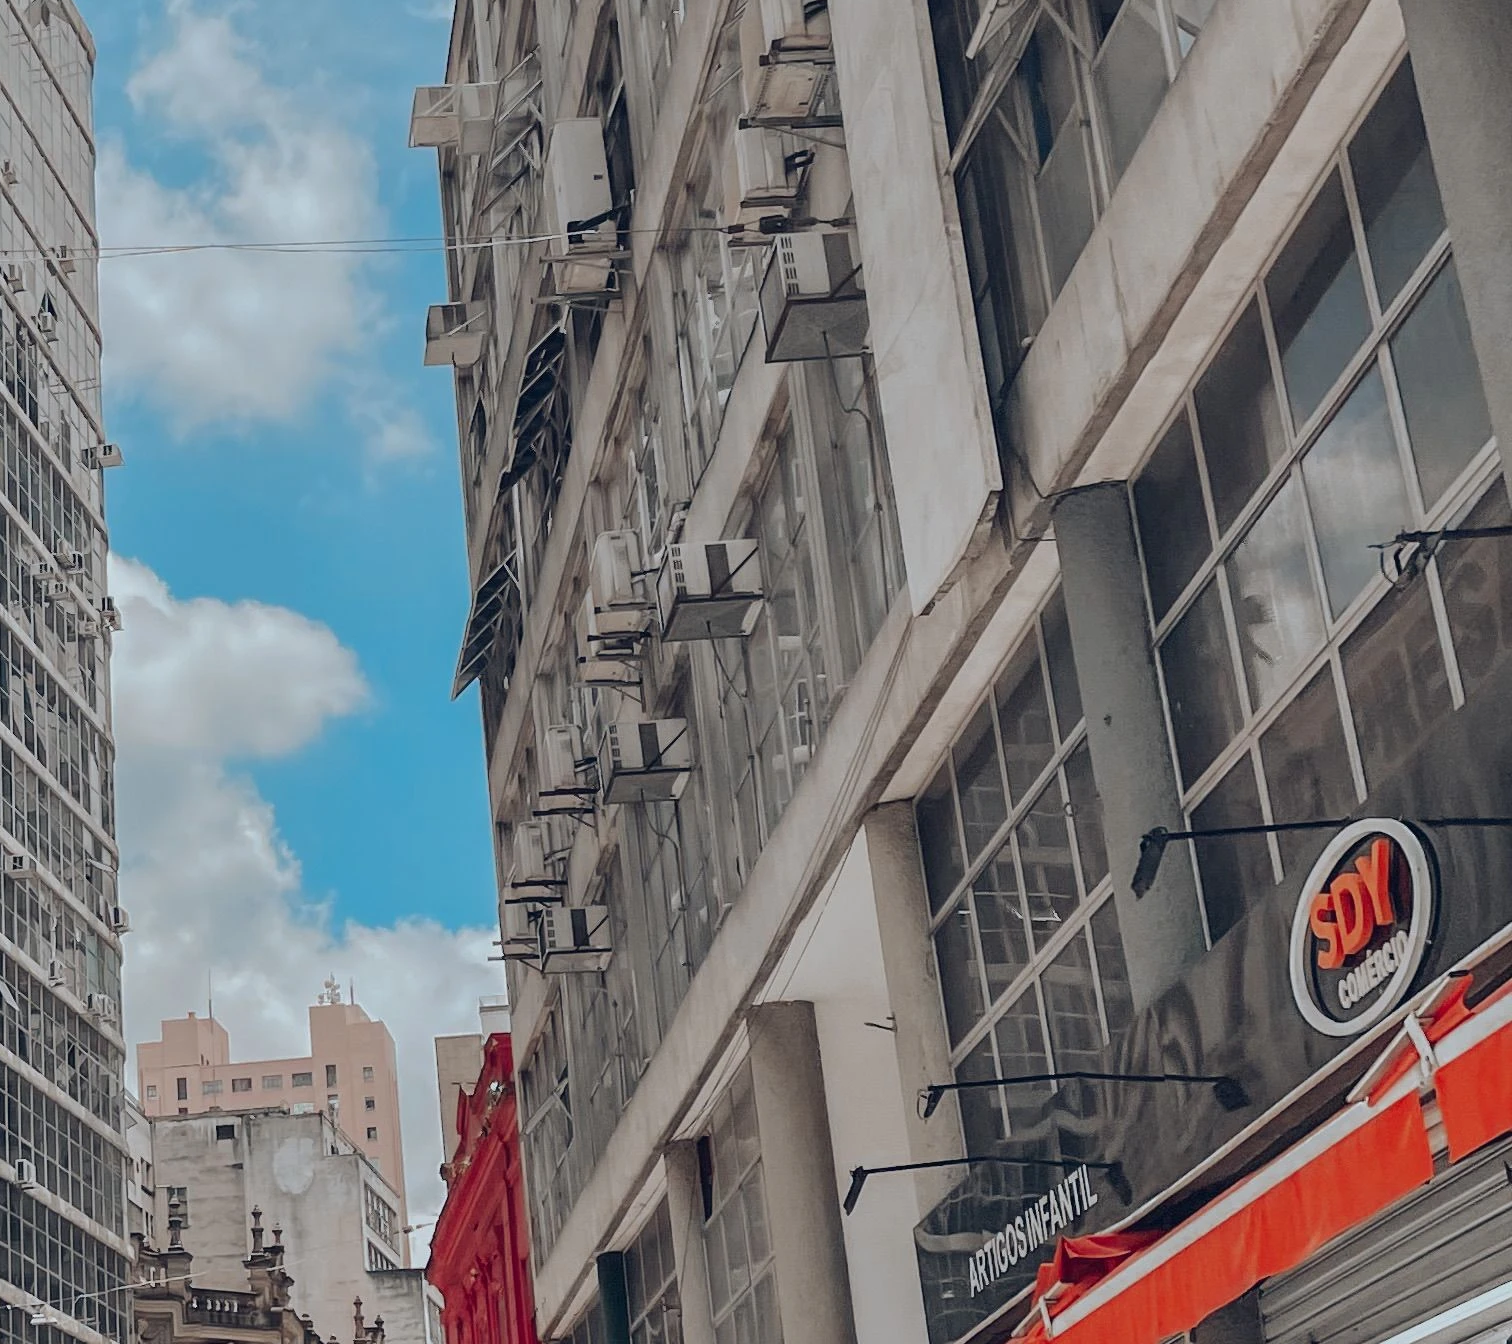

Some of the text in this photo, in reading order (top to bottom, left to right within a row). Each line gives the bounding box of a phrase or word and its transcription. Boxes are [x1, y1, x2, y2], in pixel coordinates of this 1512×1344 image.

[1310, 837, 1395, 970] SDY
[1338, 929, 1409, 1009] COMÉRCIO
[968, 1163, 1099, 1299] ARTIGOS INFANTIL
